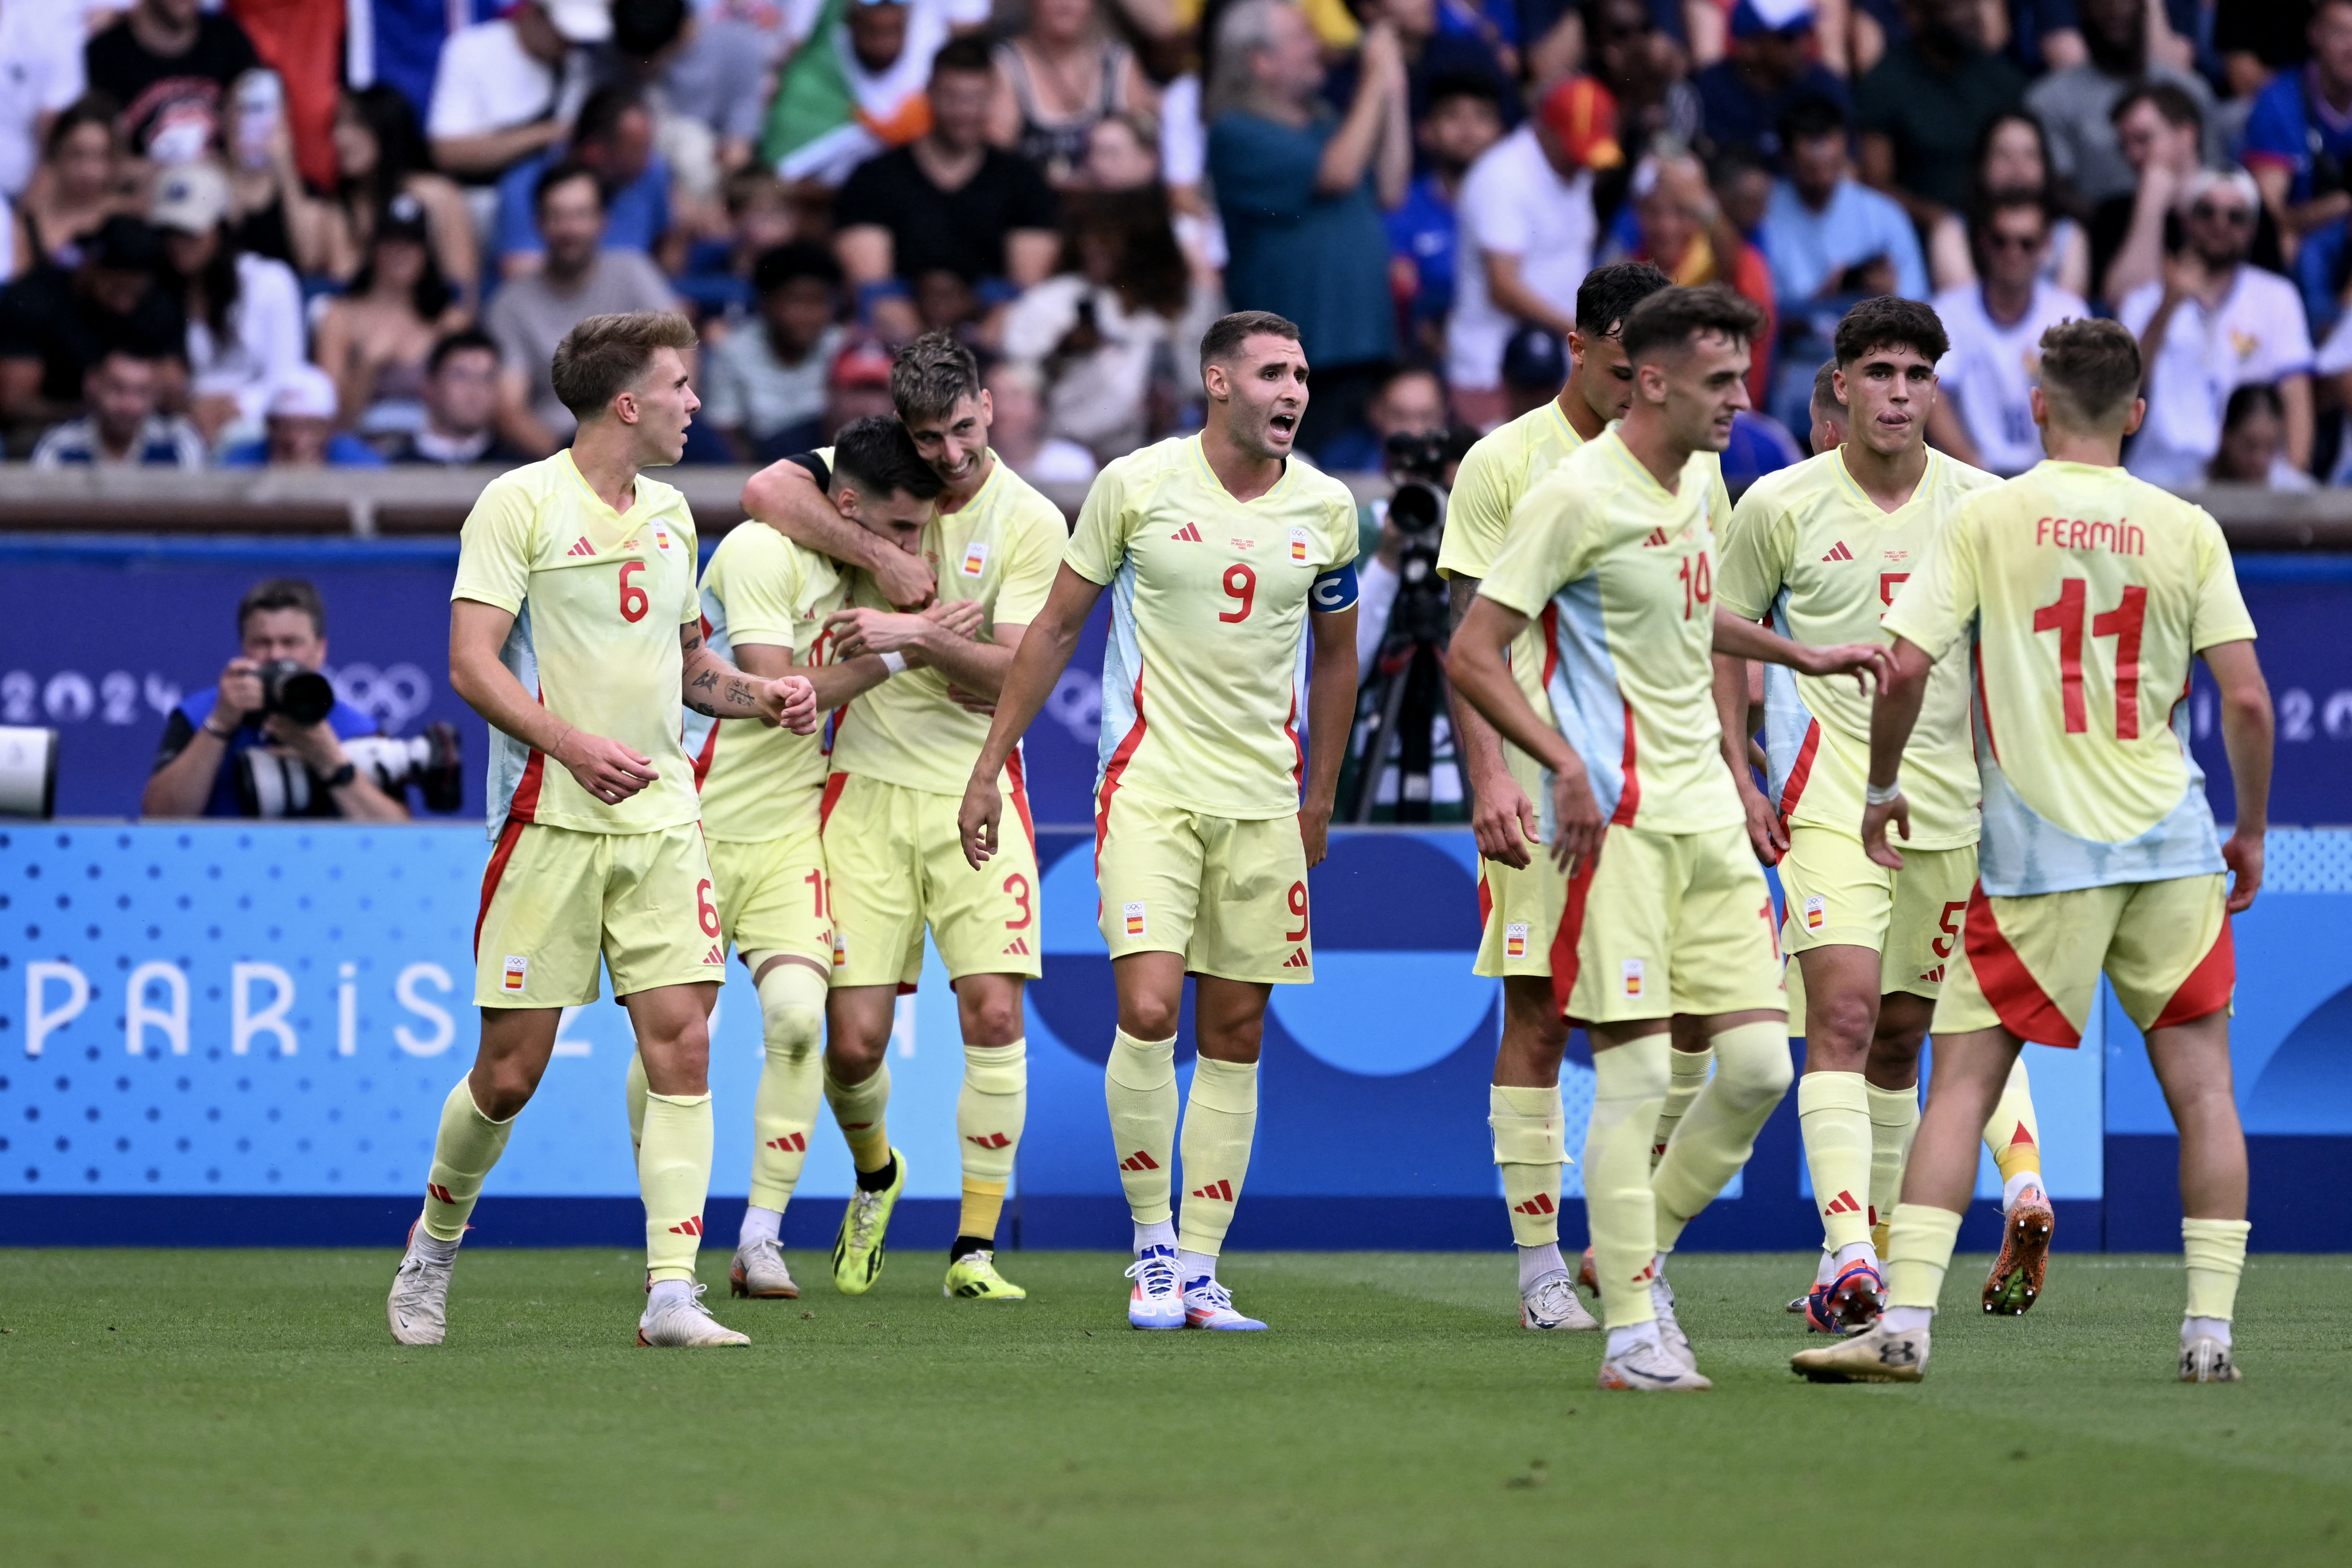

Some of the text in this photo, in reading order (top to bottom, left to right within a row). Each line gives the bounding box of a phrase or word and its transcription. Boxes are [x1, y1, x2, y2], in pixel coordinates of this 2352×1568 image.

[619, 561, 649, 623] 6
[1219, 563, 1257, 623] 9
[1313, 578, 1344, 606] C
[2033, 578, 2147, 740] 11
[697, 878, 721, 938] 6
[1003, 873, 1032, 930] 3
[1286, 880, 1308, 942] 9
[1932, 901, 1967, 959] 5
